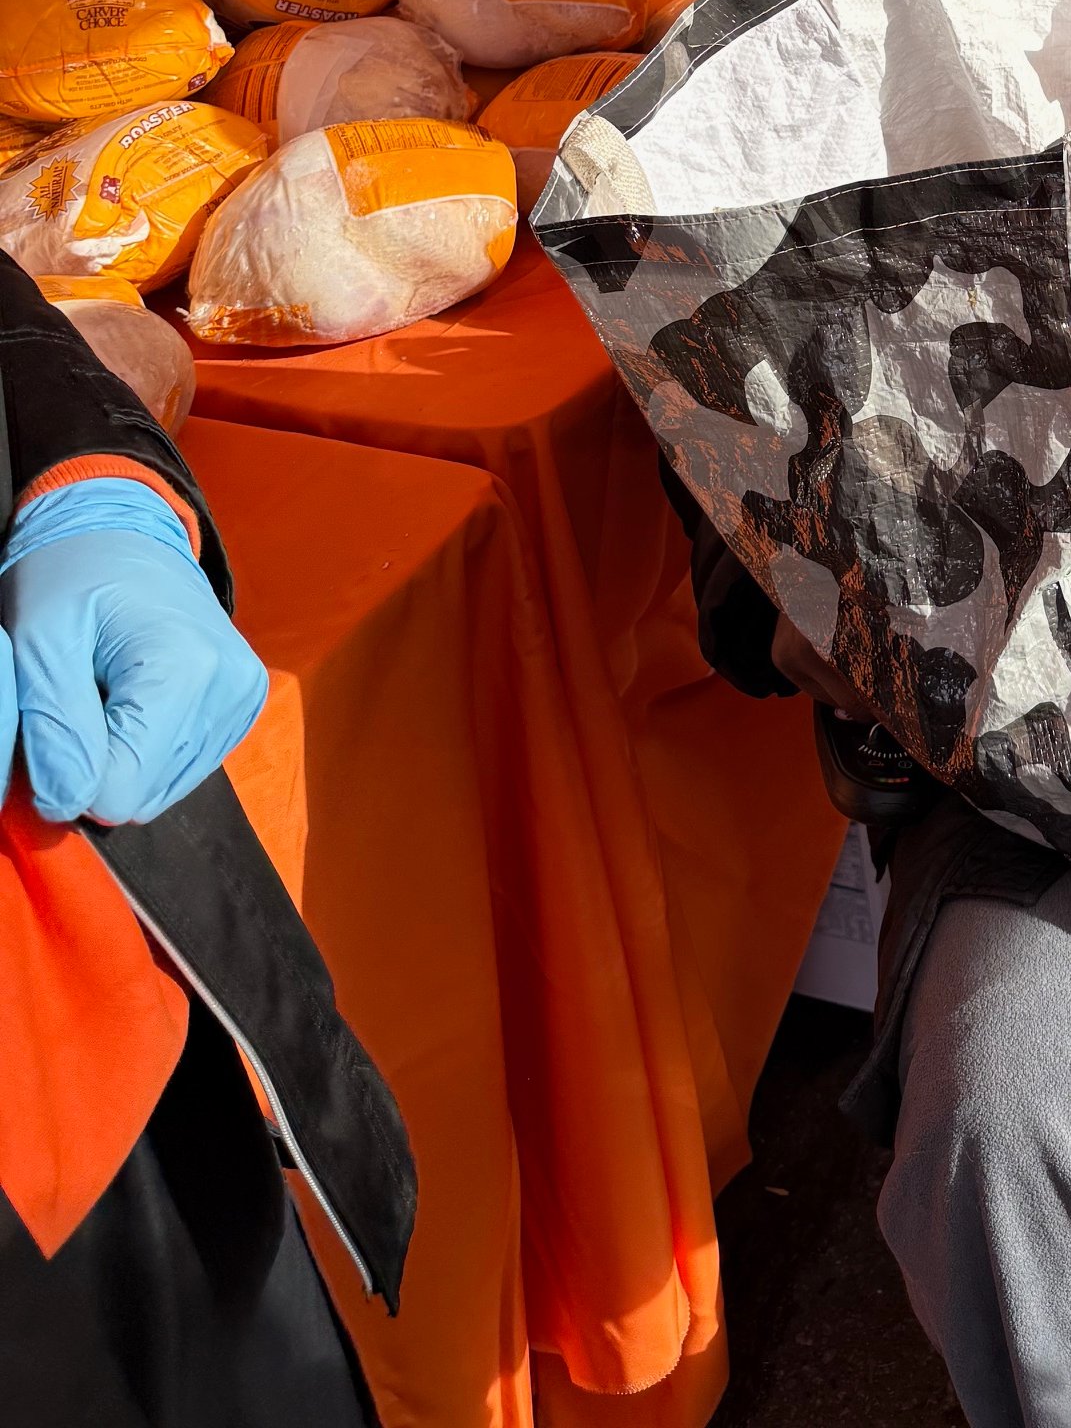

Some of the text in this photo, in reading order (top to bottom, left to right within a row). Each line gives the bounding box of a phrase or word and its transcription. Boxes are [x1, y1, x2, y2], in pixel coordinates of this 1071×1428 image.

[76, 6, 127, 21] CARVER
[79, 17, 128, 31] CHOICE
[118, 101, 196, 150] ROASTER
[41, 182, 53, 200] ALL
[50, 165, 67, 210] NATURAL
